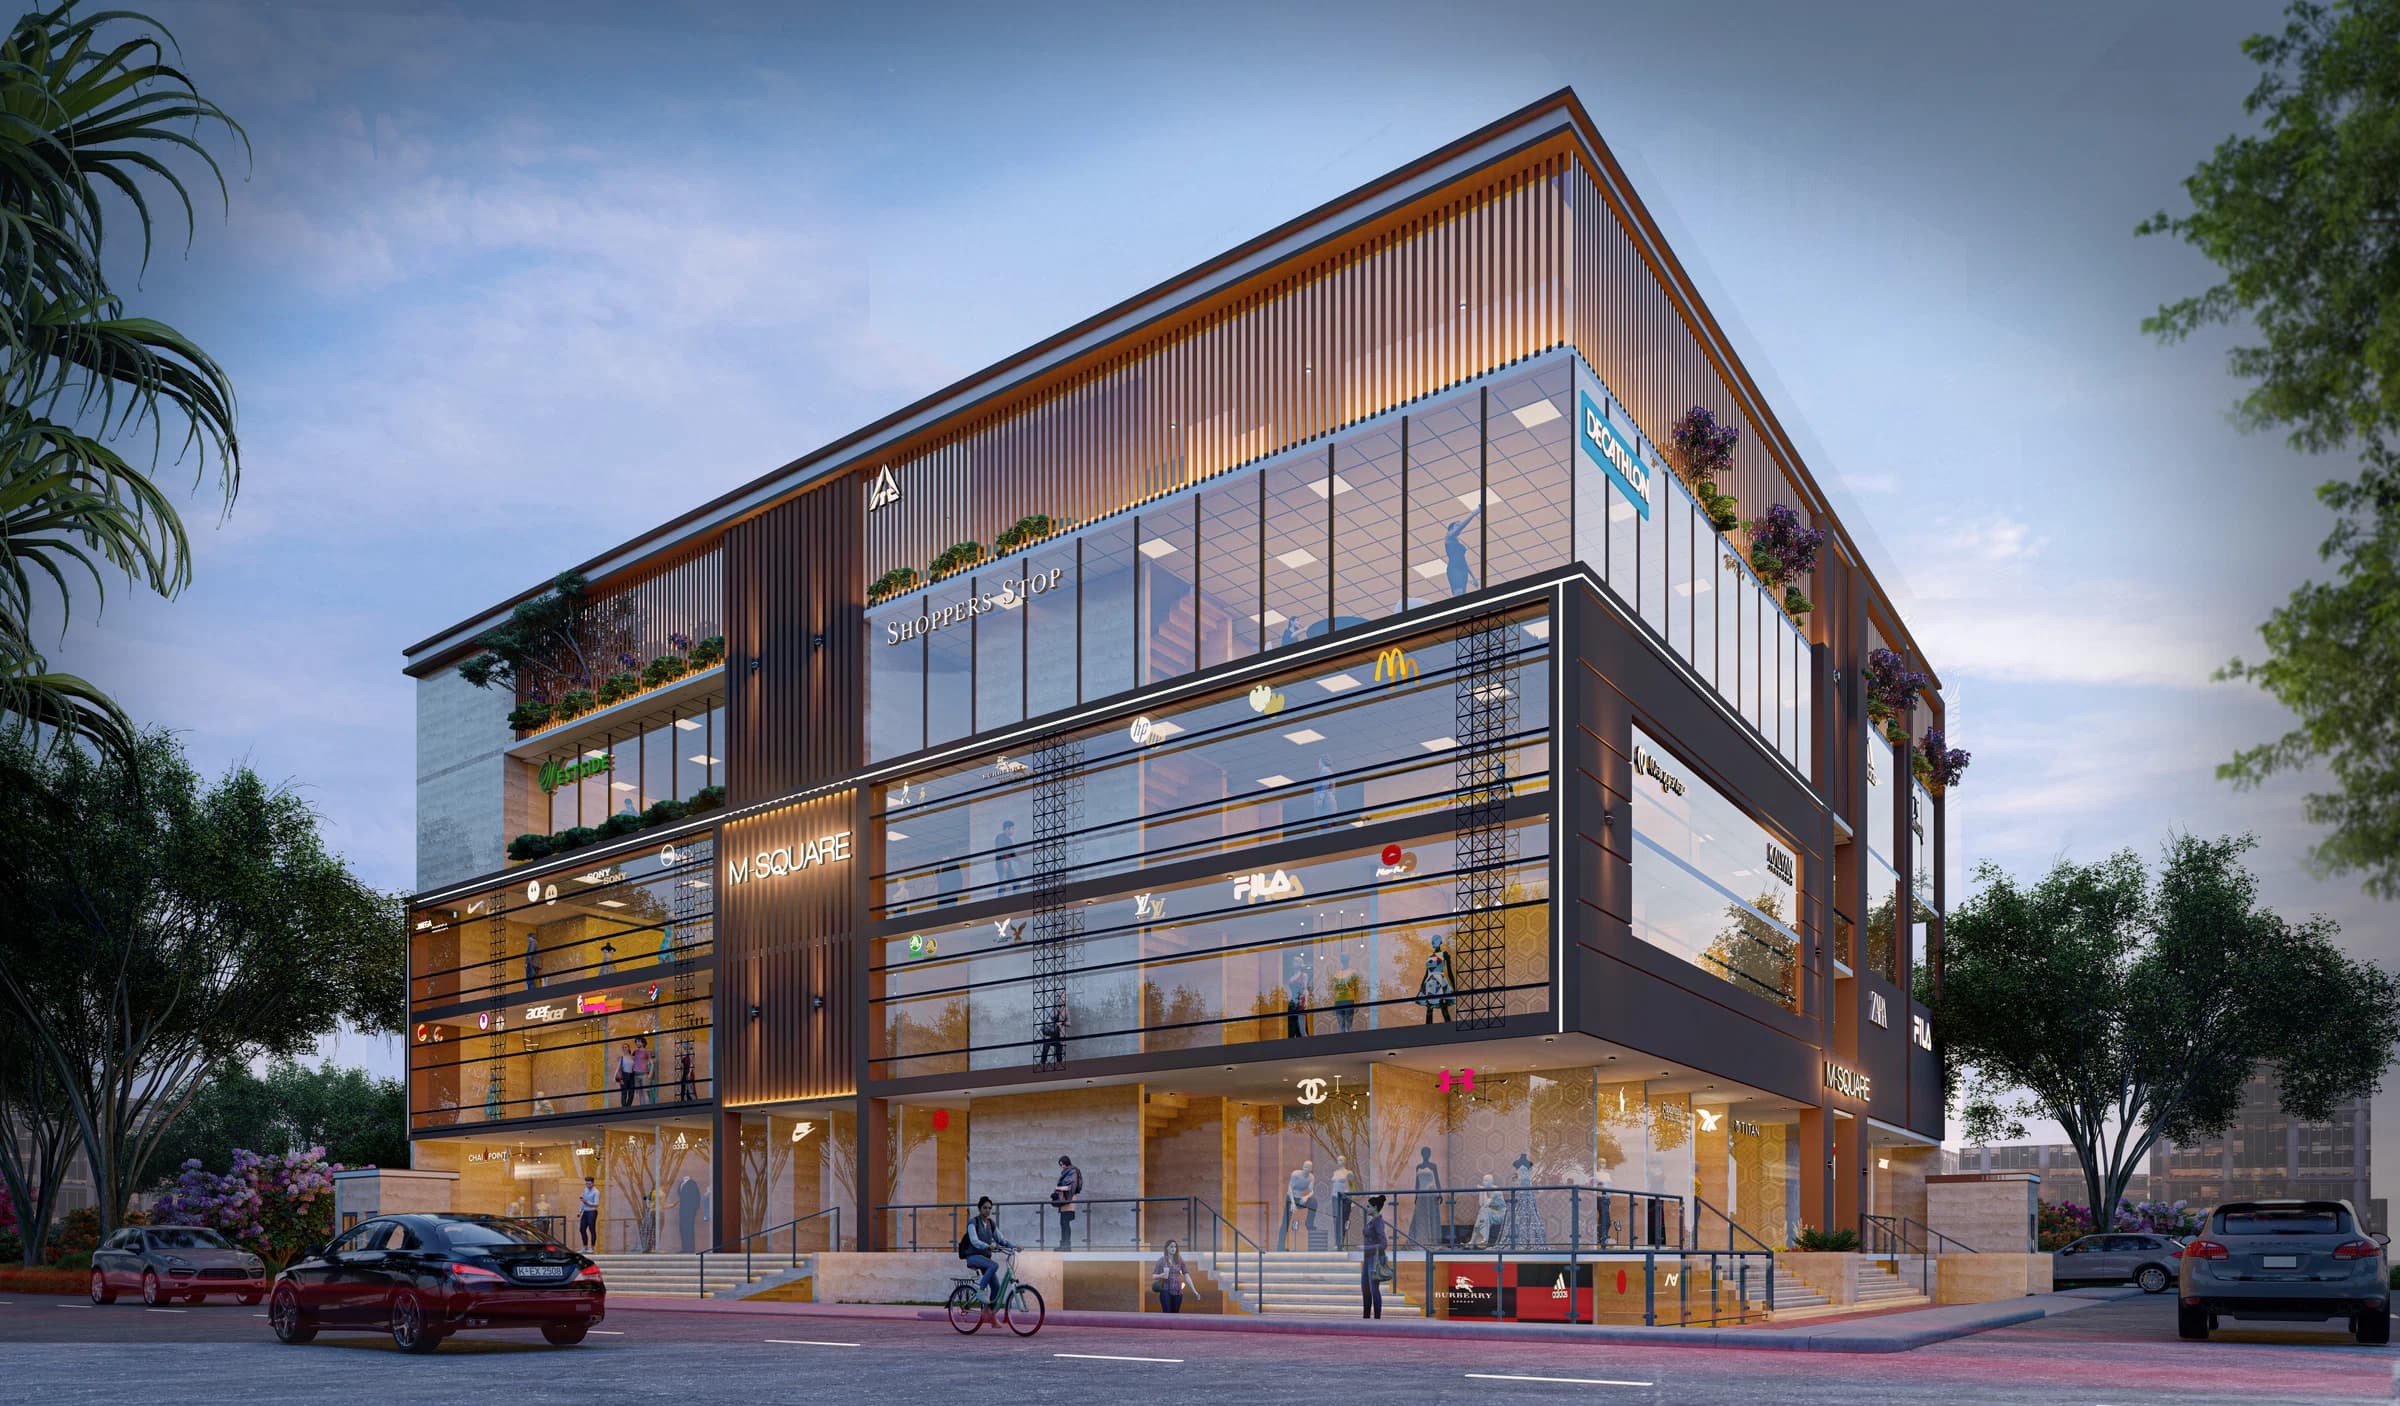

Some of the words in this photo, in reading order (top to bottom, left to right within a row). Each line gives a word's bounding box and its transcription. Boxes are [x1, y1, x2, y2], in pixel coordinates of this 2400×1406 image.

[1586, 407, 1650, 504] DECATHLON
[887, 592, 994, 646] SHOPPERS
[1002, 567, 1062, 605] STOP
[1133, 716, 1149, 744] hp
[538, 754, 610, 795] WESTSIDE
[587, 868, 611, 879] SONY
[729, 831, 852, 886] M-SQUARE
[1234, 869, 1291, 900] FILA
[526, 1005, 551, 1020] acer
[1914, 1015, 1932, 1052] FILA
[1825, 1061, 1871, 1102] M-SQUARE
[1741, 1121, 1760, 1137] TITAN
[469, 1153, 484, 1162] CHAI
[488, 1151, 507, 1161] POINT
